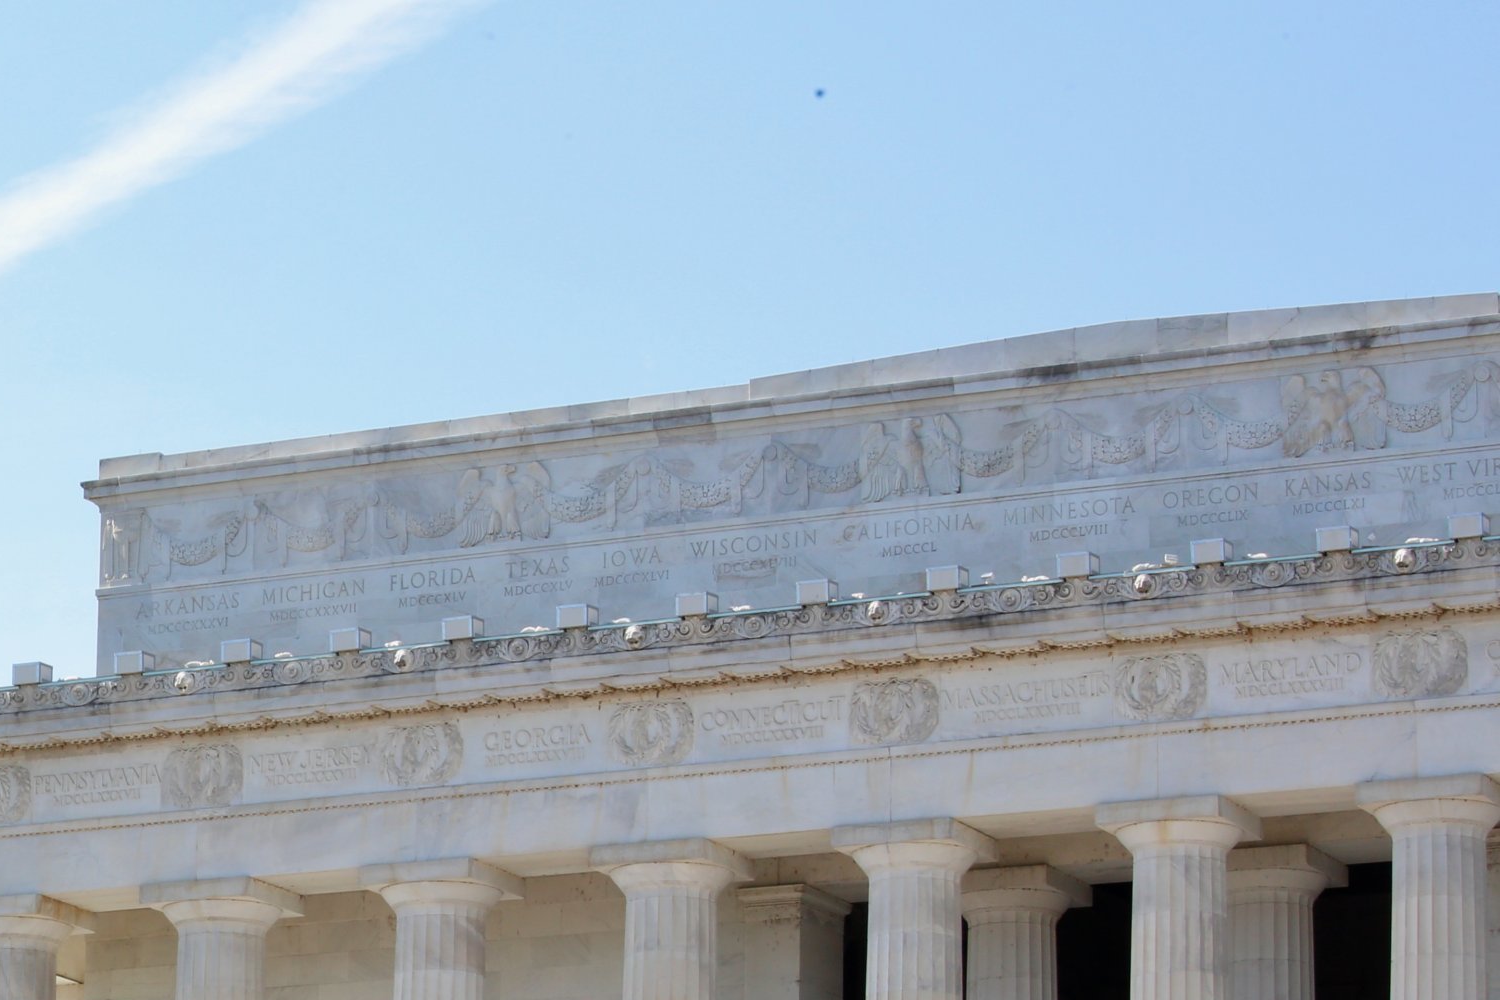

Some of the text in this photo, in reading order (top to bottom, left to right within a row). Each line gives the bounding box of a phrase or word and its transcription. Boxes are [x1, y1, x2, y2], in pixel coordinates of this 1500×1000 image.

[1285, 471, 1372, 498] KANSAS
[1396, 462, 1458, 485] WEST
[1162, 482, 1259, 510] OREGON
[1292, 497, 1366, 516] MDCCCLXI
[1003, 496, 1137, 527] MINNESOTA
[1177, 509, 1249, 528] MDCCCLIX
[842, 512, 976, 543] CALIFORNIA
[1028, 523, 1108, 543] MDCCCLVIII
[602, 545, 663, 569] IOWA
[689, 529, 818, 558] WISCONSIN
[882, 541, 938, 557] MDCCCL
[389, 566, 476, 592] FLORIDA
[505, 556, 571, 579] TEXAS
[594, 569, 670, 588] MDCCCXLVI
[262, 579, 366, 606] MICHIGAN
[398, 591, 467, 608] MDCCCXLV
[503, 580, 573, 597] MDCCCXLV
[135, 592, 240, 620] ARKANSAS
[1219, 652, 1363, 687] MARYLAND
[939, 671, 1112, 710] MASSACHUSETTS
[701, 695, 846, 732] CONNECTICUT
[483, 723, 592, 751] GEORGIA
[250, 744, 375, 774] NEW JERSEY
[33, 763, 163, 795] PENNSYLVANIA
